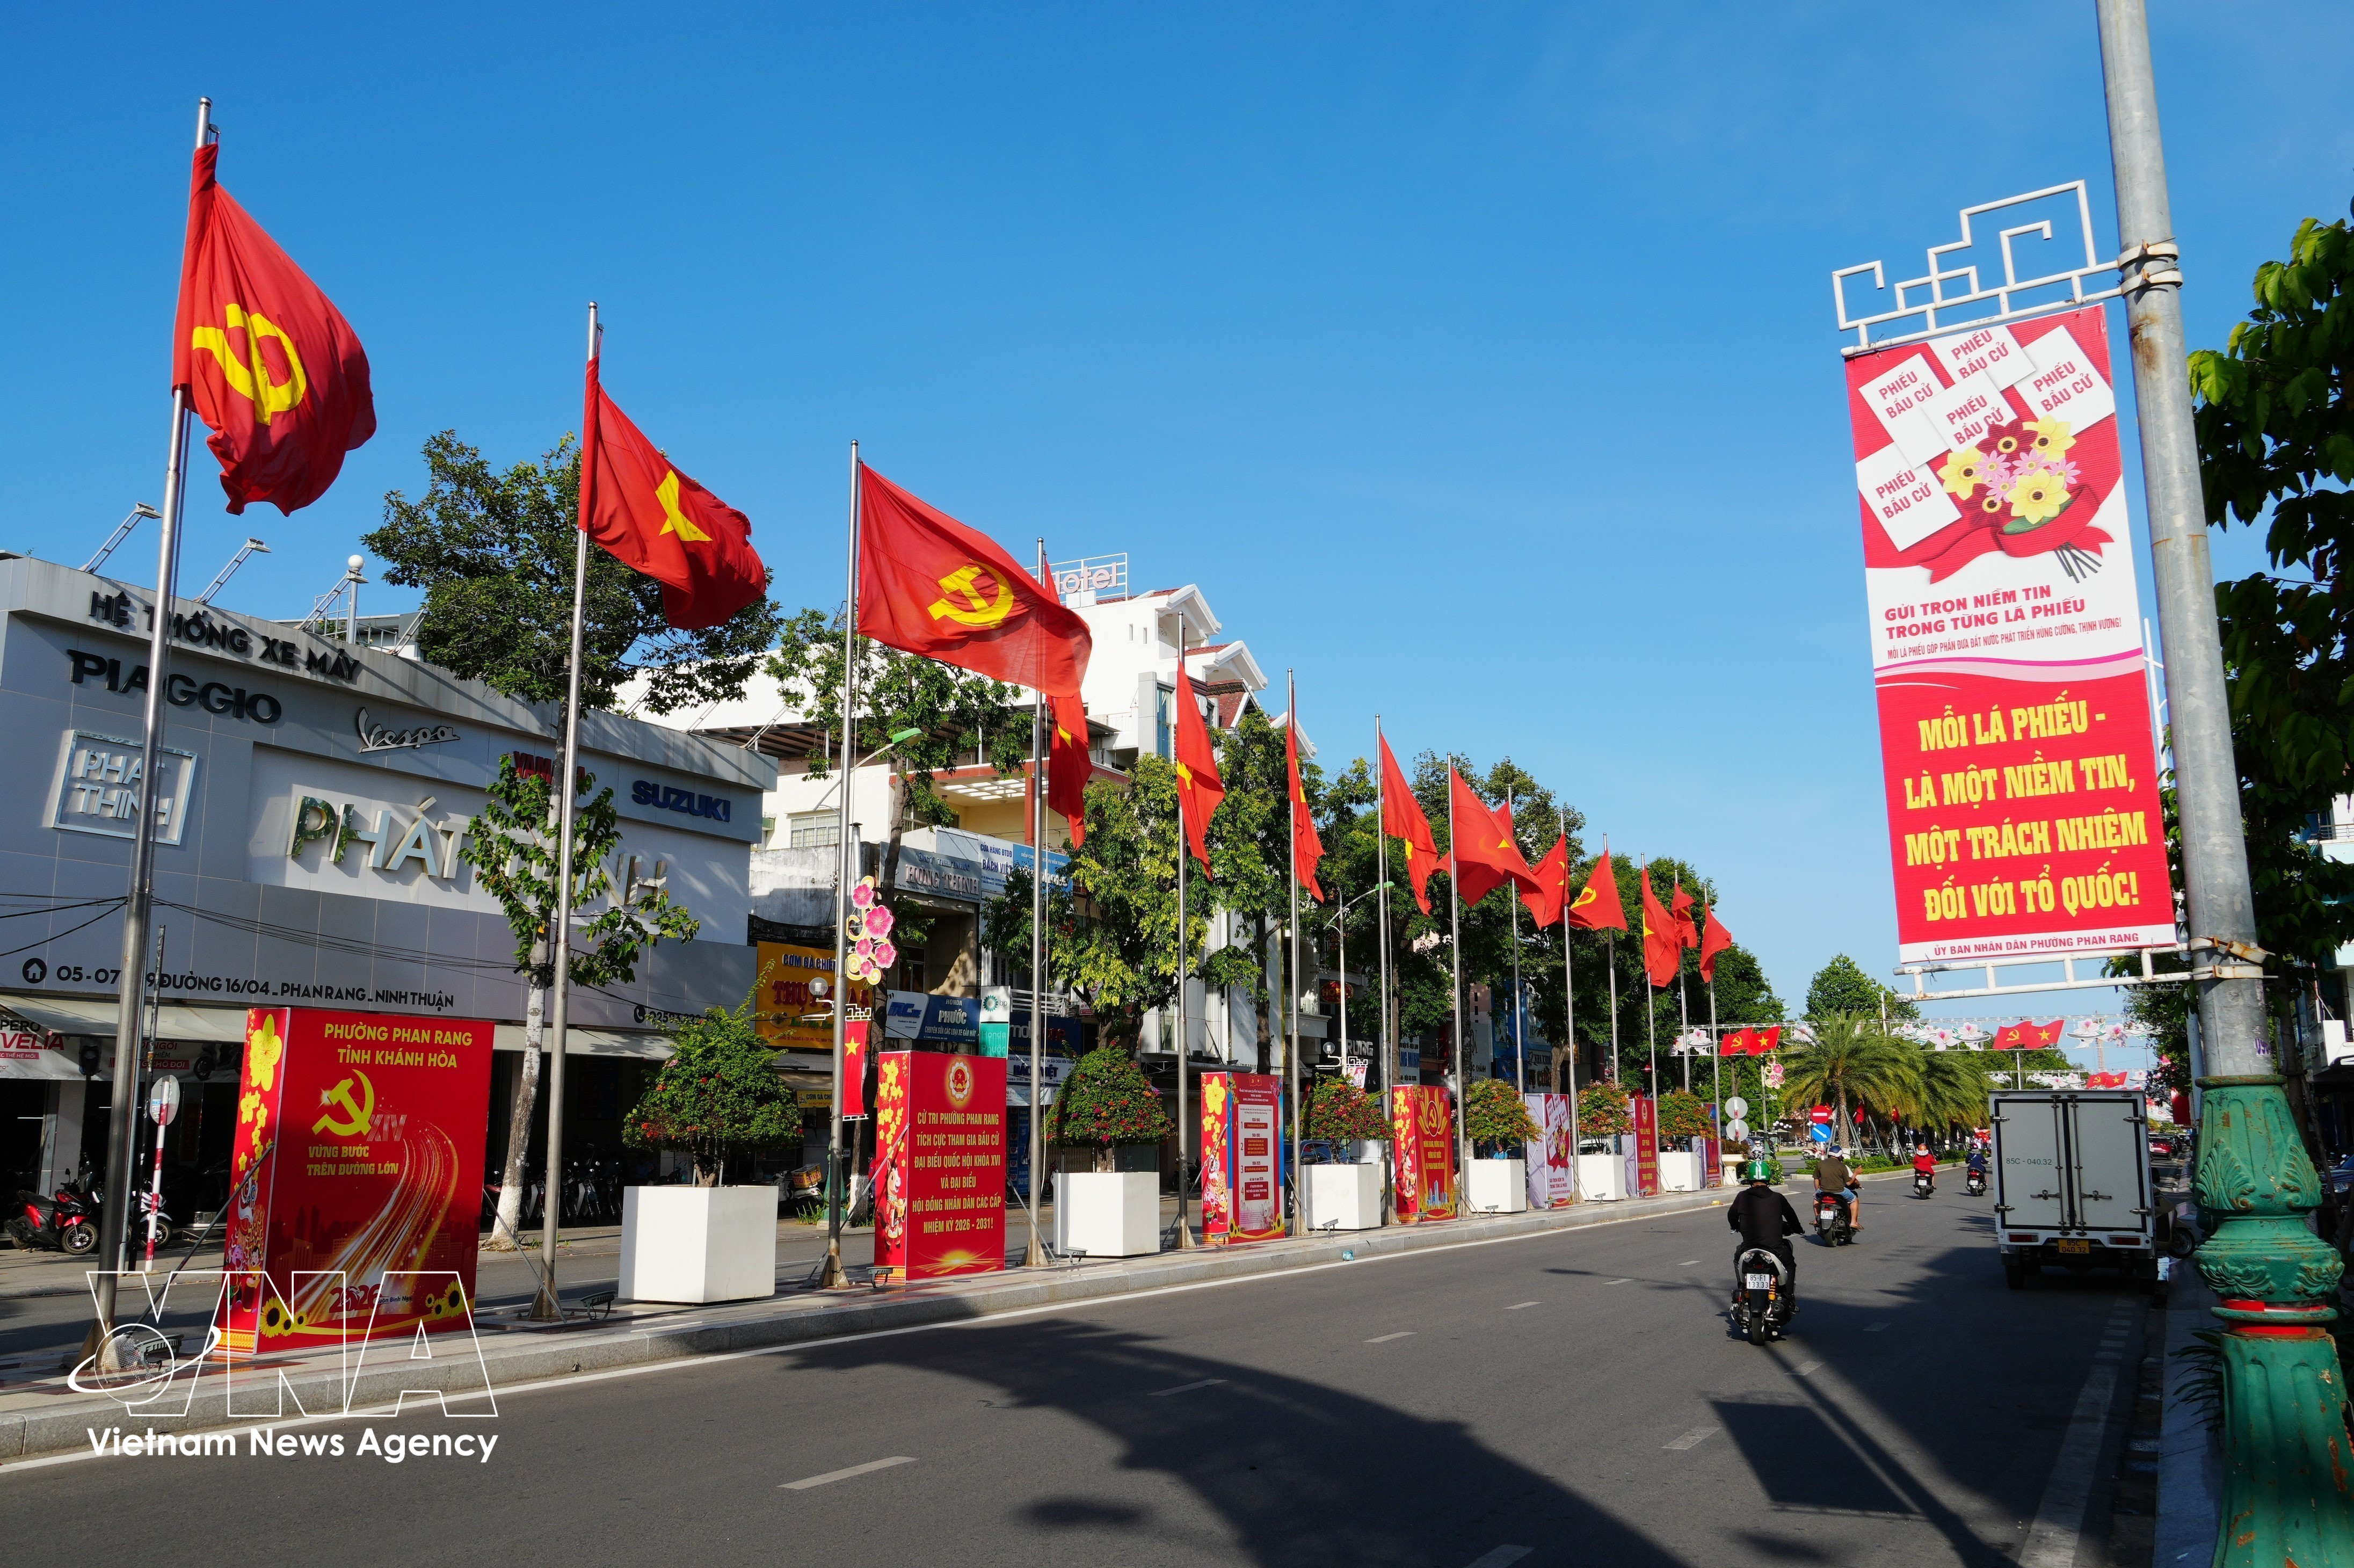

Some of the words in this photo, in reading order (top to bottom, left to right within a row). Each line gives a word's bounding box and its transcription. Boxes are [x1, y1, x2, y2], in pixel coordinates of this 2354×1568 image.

[1951, 329, 1993, 360] PHIẾU
[1958, 355, 1987, 380] BẦU
[1987, 342, 2010, 364] CỬ
[1878, 371, 1919, 401] PHIẾU
[2033, 361, 2076, 393] PHIẾU
[2041, 387, 2071, 412] BẦU
[2070, 373, 2094, 396] CỬ
[1885, 396, 1913, 419] BẦU
[1914, 383, 1934, 404] CỬ
[1946, 395, 1988, 425] PHIẾU
[1954, 419, 1983, 445] BẦU
[1984, 407, 2005, 427] CỬ
[1876, 469, 1916, 498] PHIẾU
[1882, 495, 1911, 519] BẦU
[1910, 482, 1932, 504] CỬ
[1885, 602, 1915, 622] GỬI
[1920, 596, 1967, 617] TRỌN
[1974, 589, 2017, 607] NIỀM
[2022, 585, 2051, 601] TIN
[1886, 621, 1945, 640] TRONG
[1952, 612, 1999, 632] TỪNG
[2005, 606, 2025, 623] LÁ
[2031, 598, 2086, 620] PHIẾU
[89, 590, 130, 627] HỆ
[143, 604, 249, 653] THỐNG
[260, 636, 296, 666] XE
[306, 648, 360, 680] MÁY
[1887, 648, 1899, 659] MỖI
[1900, 645, 1907, 657] LÁ
[1909, 642, 1926, 657] PHIẾU
[1927, 641, 1938, 655] GÓP
[1939, 638, 1956, 653] PHẦN
[1957, 637, 1968, 651] ĐƯA
[1970, 634, 1981, 649] ĐẤT
[1983, 631, 1999, 646] NƯỚC
[2001, 629, 2016, 644] PHÁT
[2017, 626, 2035, 643] TRIỂN
[2037, 625, 2053, 640] HÙNG
[2054, 622, 2077, 638] CƯỜNG,
[2079, 621, 2097, 635] THỊNH
[2098, 616, 2122, 634] VƯỢNG!
[67, 649, 282, 723] PIAGGIO
[357, 707, 461, 753] Vespa
[1919, 705, 1968, 752] MỖI
[1973, 704, 2007, 745] LÁ
[2011, 689, 2087, 741] PHIẾU
[1904, 771, 1937, 810] LÀ
[1941, 764, 1997, 809] MỘT
[2004, 750, 2075, 800] NIỀM
[2080, 753, 2135, 793] TIN,
[632, 780, 731, 822] SUZUKI
[287, 796, 475, 879] PHÁT
[990, 845, 1000, 855] HÀNG
[1905, 824, 1961, 870] MỘT
[1966, 817, 2051, 858] TRÁCH
[2056, 807, 2148, 854] NHIỆM
[982, 858, 998, 873] BÁCH
[942, 872, 980, 896] THỊNH
[1924, 875, 1967, 921] ĐỐI
[1971, 876, 2016, 917] VỚI
[2021, 864, 2055, 913] TỔ
[2061, 861, 2140, 917] QUỐC!
[1934, 941, 1948, 957] ỦY
[1950, 943, 1972, 955] BAN
[1974, 940, 2003, 954] NHÂN
[2006, 938, 2028, 952] DÂN
[2030, 936, 2075, 950] PHƯỜNG
[2077, 935, 2107, 948] PHAN
[2109, 933, 2139, 946] RANG
[783, 954, 801, 967] CƠM
[803, 955, 814, 969] GÀ
[57, 966, 83, 982] 05
[95, 969, 121, 984] 07
[161, 971, 222, 992] ĐƯỜNG
[226, 979, 270, 994] 16/04
[376, 989, 408, 1005] NINH
[410, 990, 454, 1012] THUẬN
[938, 1008, 967, 1025] PHƯỚC
[324, 1022, 388, 1041] PHƯỜNG
[393, 1027, 430, 1044] PHAN
[434, 1030, 473, 1047] RANG
[338, 1045, 370, 1064] TỈNH
[376, 1048, 424, 1066] KHÁNH
[428, 1051, 457, 1068] HÒA
[918, 1109, 927, 1126] CỬ
[928, 1113, 939, 1124] TRI
[940, 1110, 965, 1126] PHƯỜNG
[967, 1113, 982, 1125] PHAN
[984, 1113, 999, 1126] RANG
[341, 1143, 369, 1158] BƯỚC
[917, 1131, 932, 1146] TÍCH
[933, 1134, 947, 1148] CỰC
[948, 1134, 965, 1146] THAM
[967, 1134, 977, 1146] GIA
[978, 1131, 990, 1146] BẦU
[991, 1130, 999, 1145] CỬ
[307, 1163, 336, 1175] TRÊN
[339, 1162, 375, 1175] ĐƯỜNG
[378, 1160, 398, 1174] LỚN
[914, 1156, 926, 1170] ĐẠI
[927, 1151, 942, 1168] BIỂU
[943, 1151, 961, 1168] QUỐC
[962, 1153, 973, 1168] HỘI
[974, 1153, 990, 1167] KHÓA
[991, 1155, 1000, 1166] XVI
[941, 1174, 949, 1189] VÀ
[950, 1176, 962, 1190] ĐẠI
[963, 1171, 976, 1188] BIỂU
[913, 1197, 925, 1215] HỘI
[925, 1196, 943, 1211] ĐỒNG
[944, 1196, 962, 1210] NHÂN
[963, 1195, 975, 1209] DÂN
[976, 1194, 989, 1209] CÁC
[989, 1192, 1002, 1208] CẤP
[924, 1219, 944, 1236] NHIỆM
[946, 1218, 954, 1232] KỲ
[955, 1219, 970, 1231] 2026
[976, 1218, 993, 1230] 2031!
